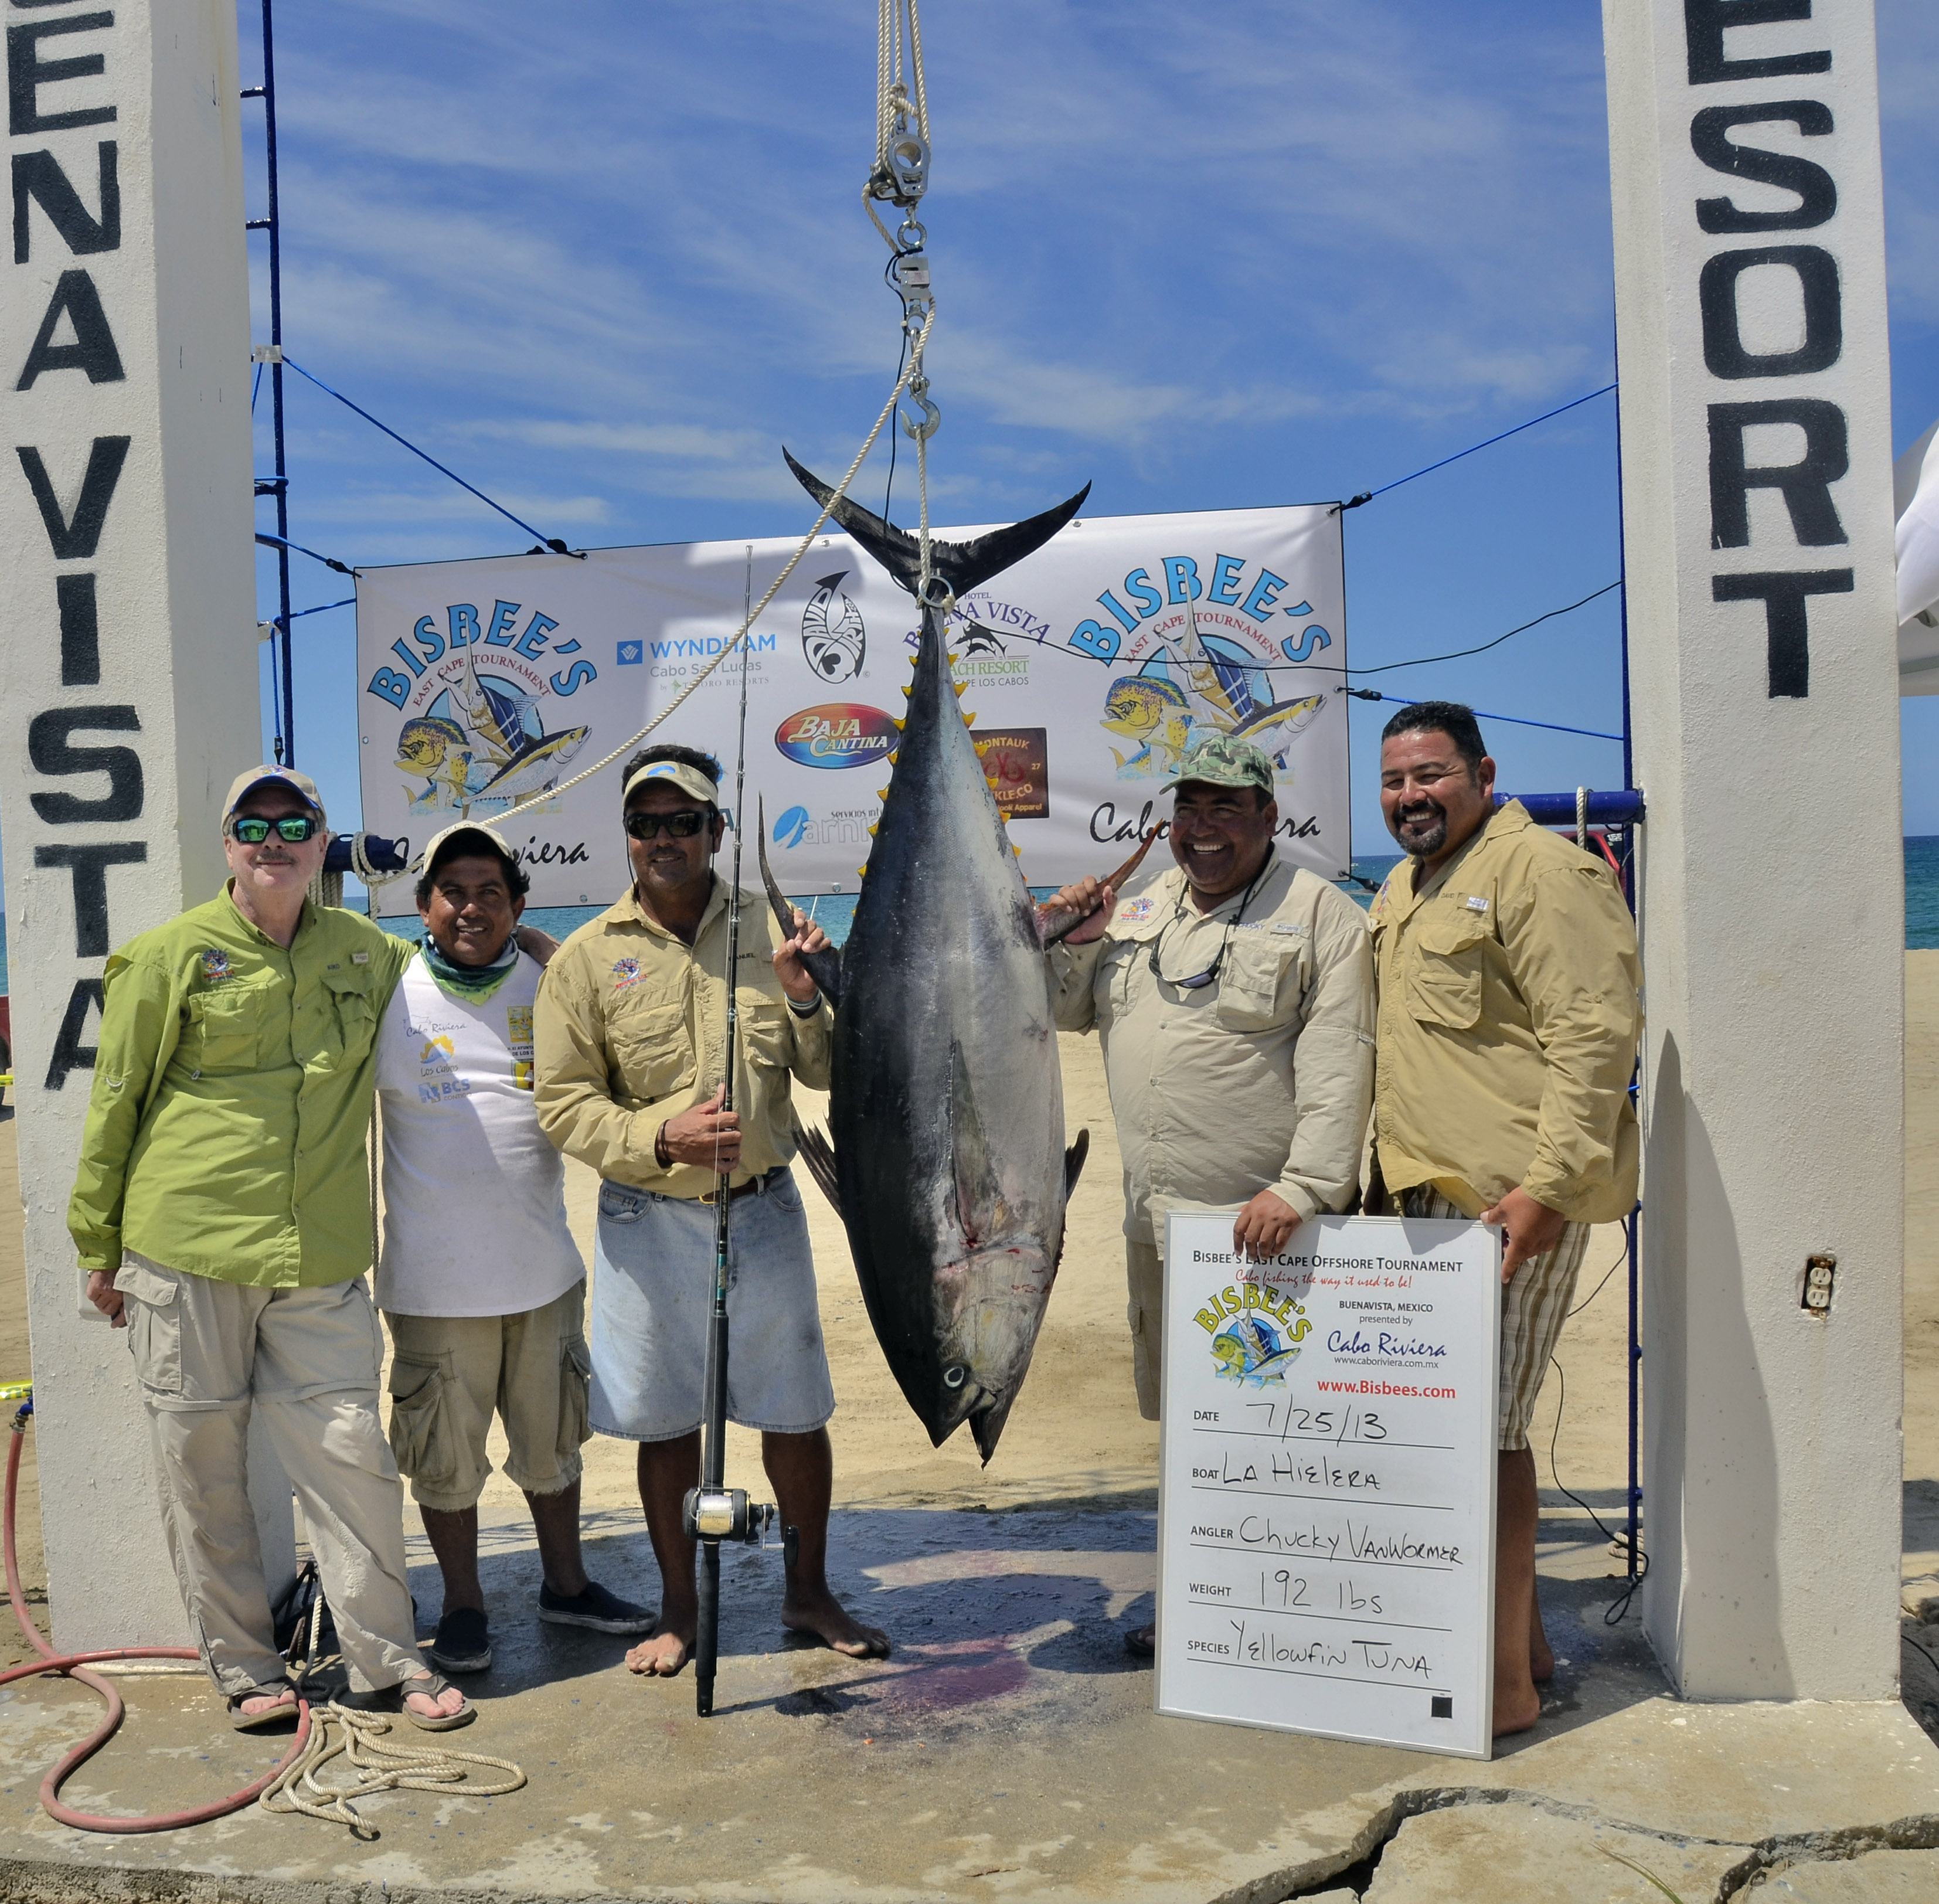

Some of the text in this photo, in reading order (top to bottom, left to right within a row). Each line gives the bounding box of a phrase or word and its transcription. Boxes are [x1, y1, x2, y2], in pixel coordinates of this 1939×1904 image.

[7, 0, 147, 1090] ENA VISTA
[1067, 553, 1332, 668] BISBEE'S
[903, 601, 1050, 650] BENA VISTA
[1124, 613, 1283, 665] EAST CAPE TOURNAMENT
[367, 599, 597, 712] BISBEE'S
[650, 665, 686, 678] Cabo
[722, 661, 762, 673] Lucas
[950, 660, 1030, 676] ACH RESORT
[413, 654, 551, 707] EAST CAPE TOURNAMENT
[683, 680, 722, 689] TORO
[726, 676, 770, 686] RESORTS
[979, 678, 995, 686] LOS
[998, 676, 1029, 686] CABOS
[787, 715, 861, 743] BAJA
[809, 735, 888, 757] CANTINA
[993, 783, 1033, 800] KLE.CO
[1014, 803, 1042, 812] Apparel
[729, 953, 756, 961] ANUEL
[406, 1023, 468, 1038] Cabo Riviera
[421, 1064, 459, 1077] Los Cabos
[441, 1078, 471, 1094] BCS
[1193, 1250, 1242, 1264] BISBEE'S
[1278, 1253, 1308, 1267] CAPE
[1311, 1255, 1373, 1270] OFFSHORE
[1376, 1257, 1463, 1273] TOURNAMENT
[1236, 1269, 1413, 1290] Cabo fishing the way it used to be!
[1192, 1282, 1313, 1342] BISBEE'S
[1339, 1300, 1434, 1313] BUENAVISTA, MEXICO
[1359, 1315, 1413, 1327] presented by
[1327, 1330, 1447, 1358] Cabo Riviera
[1334, 1356, 1439, 1369] www.caboriviera.com.mx
[1317, 1379, 1456, 1399] www.Bisbees.com
[1193, 1410, 1220, 1423] DATE
[1246, 1393, 1388, 1447] 7/25/13
[1192, 1467, 1219, 1480] BOAT
[1223, 1451, 1258, 1484] LA
[1190, 1525, 1234, 1539] ANGLER
[1239, 1515, 1340, 1562] Chucky
[1189, 1582, 1232, 1598] WEIGHT
[1261, 1570, 1383, 1614] 192 lbs
[1187, 1640, 1230, 1655] SPECIES
[1230, 1619, 1433, 1680] Yellowfin TUNA
